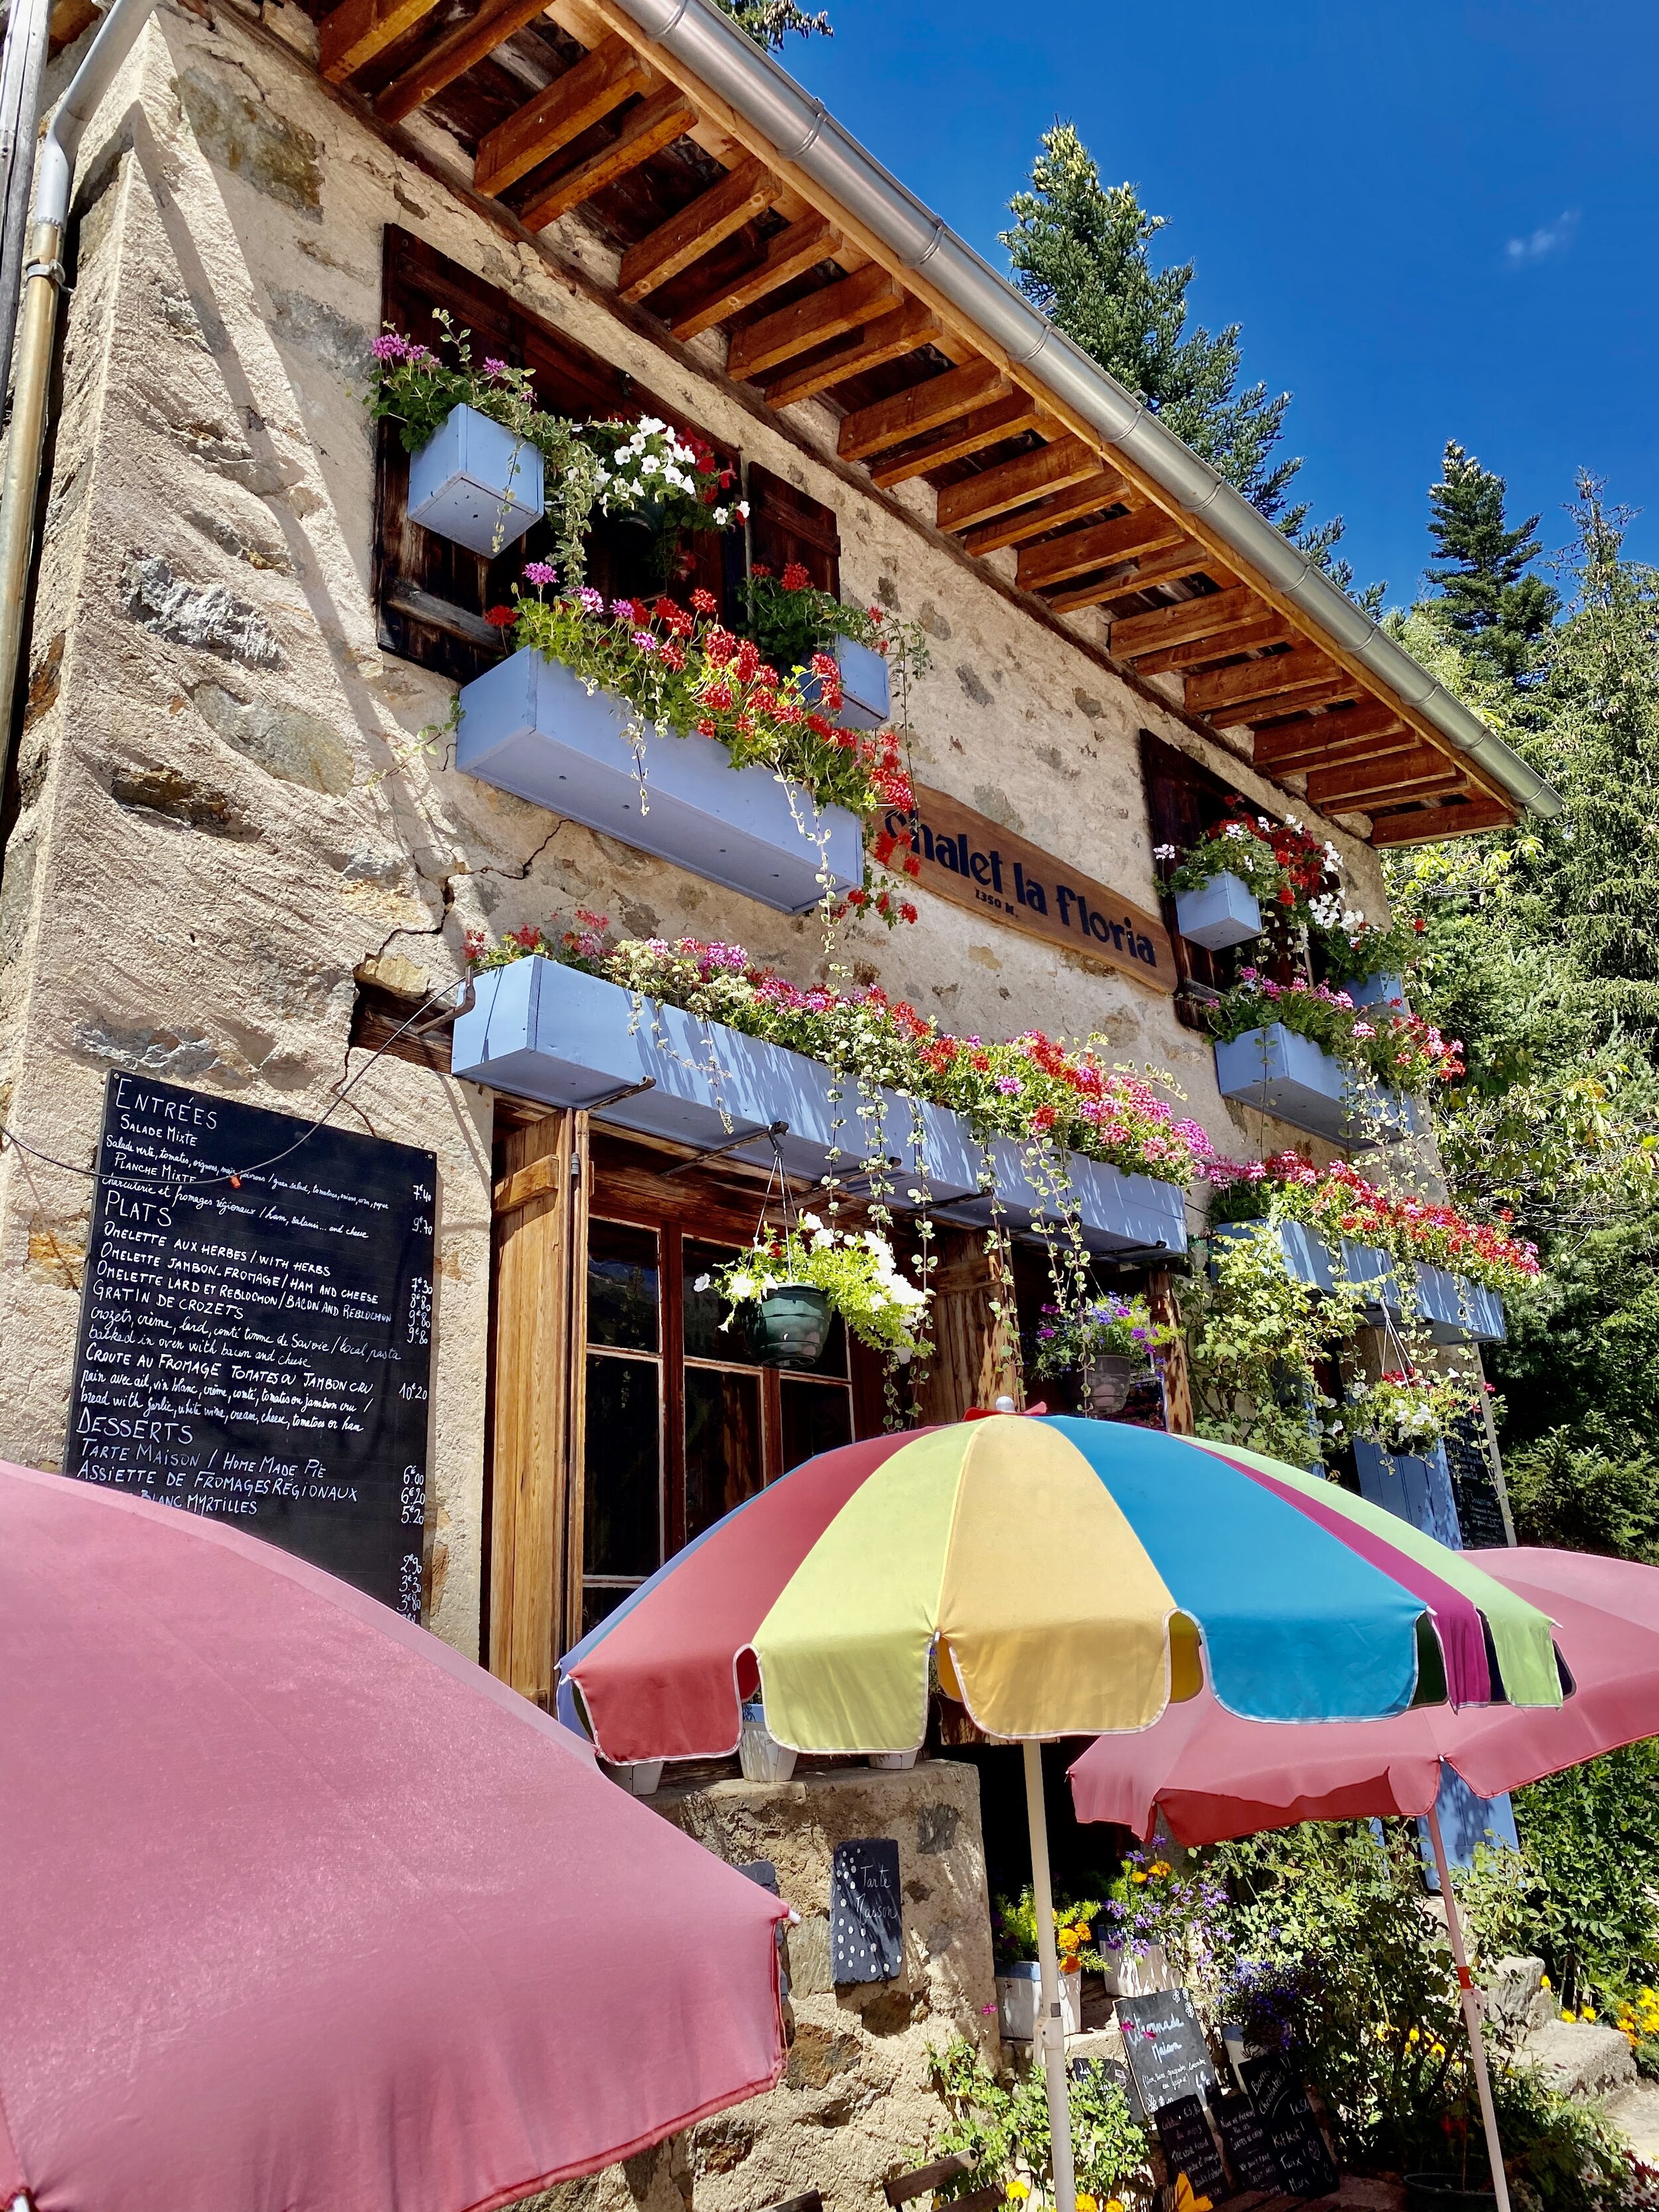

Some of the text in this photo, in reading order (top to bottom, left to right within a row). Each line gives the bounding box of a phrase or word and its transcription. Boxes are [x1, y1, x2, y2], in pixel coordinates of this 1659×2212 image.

[885, 808, 1003, 894] Chalet
[1013, 863, 1048, 916] la
[115, 1078, 218, 1130] ENTRÉES
[106, 1135, 134, 1151] Salade
[120, 1114, 163, 1138] SALADE
[114, 1152, 158, 1175] PLANCHE
[104, 1190, 172, 1227] PLATS
[158, 1185, 171, 1197] et
[172, 1185, 212, 1209] fromages
[104, 1220, 330, 1276] OMELETTE AUX HERBES WITH HERBS
[97, 1260, 163, 1287] OMELETTE
[168, 1277, 200, 1293] LARD
[204, 1285, 216, 1295] ET
[285, 1294, 321, 1311] BACON
[321, 1303, 339, 1317] AND
[100, 1242, 161, 1267] OMELETTE
[290, 1278, 313, 1294] HAM
[319, 1284, 337, 1297] AND
[341, 1289, 379, 1305] CHEESE
[93, 1279, 244, 1319] GRATIN DE CROZETS
[137, 1334, 155, 1345] in
[159, 1339, 184, 1349] oven
[189, 1339, 217, 1354] with
[220, 1342, 252, 1358] bacon
[255, 1349, 275, 1362] and
[277, 1352, 311, 1367] cheese
[277, 1333, 289, 1347] de
[291, 1333, 329, 1352] Savoie
[366, 1343, 401, 1363] pasta
[80, 1369, 106, 1388] pain
[109, 1373, 133, 1386] avec
[153, 1378, 169, 1390] vin
[261, 1388, 290, 1404] tomates
[301, 1394, 336, 1412] jambon
[339, 1402, 357, 1412] cru
[136, 1354, 155, 1368] AU
[158, 1353, 222, 1379] FROMAGE
[232, 1364, 280, 1384] TOMATES
[303, 1372, 348, 1392] JAMBON
[76, 1406, 193, 1445] DESSERTS
[80, 1385, 110, 1405] bread
[113, 1392, 143, 1408] with
[292, 1413, 325, 1428] tomatoes
[341, 1416, 364, 1432] ham
[82, 1438, 131, 1461] TARTE
[222, 1451, 257, 1473] HOME
[259, 1456, 298, 1477] MADE
[166, 1471, 186, 1487] DE
[194, 1471, 271, 1498] FROMAGES
[860, 1864, 891, 1888] Tarte
